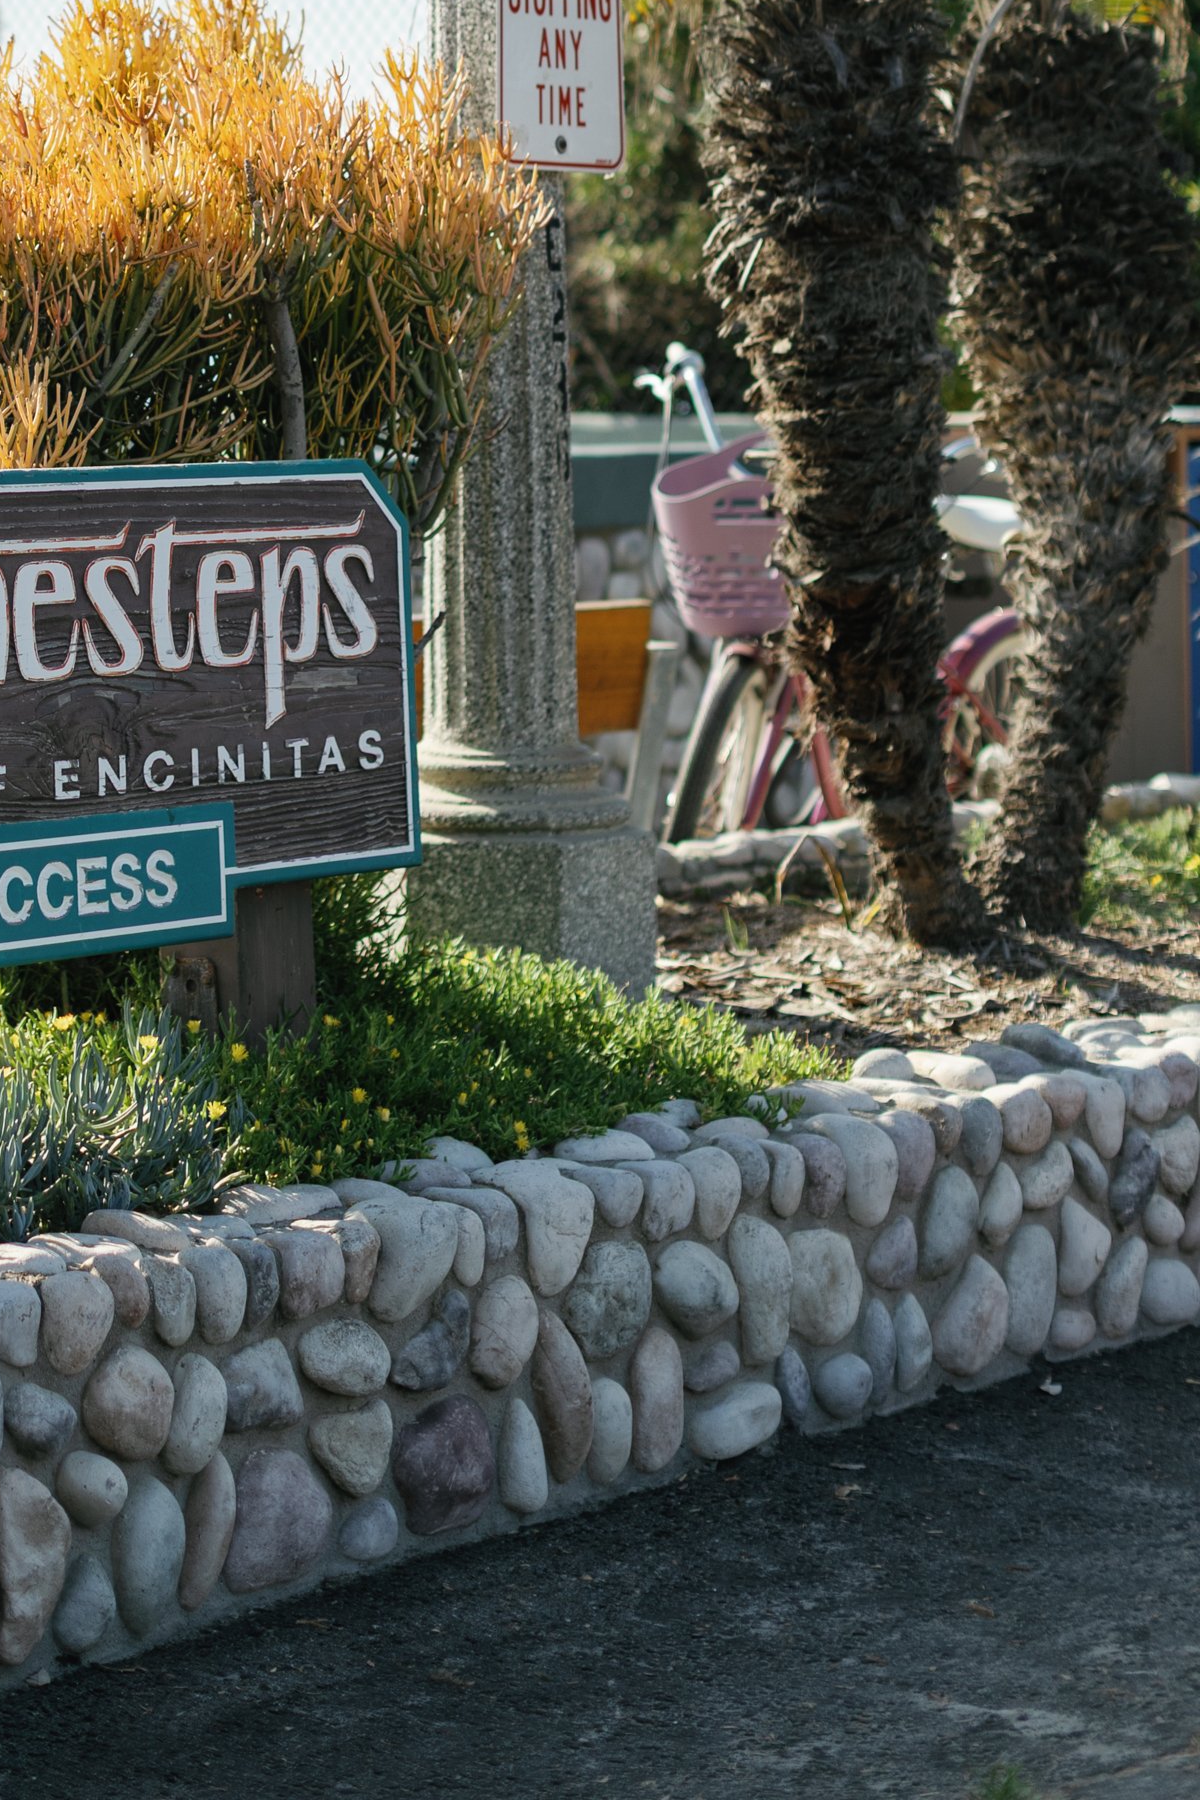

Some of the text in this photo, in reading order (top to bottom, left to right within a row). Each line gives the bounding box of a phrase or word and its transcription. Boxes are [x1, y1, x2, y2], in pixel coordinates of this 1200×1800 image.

[538, 27, 582, 71] ANY
[536, 84, 587, 128] TIME
[53, 728, 385, 800] ENCINITAS
